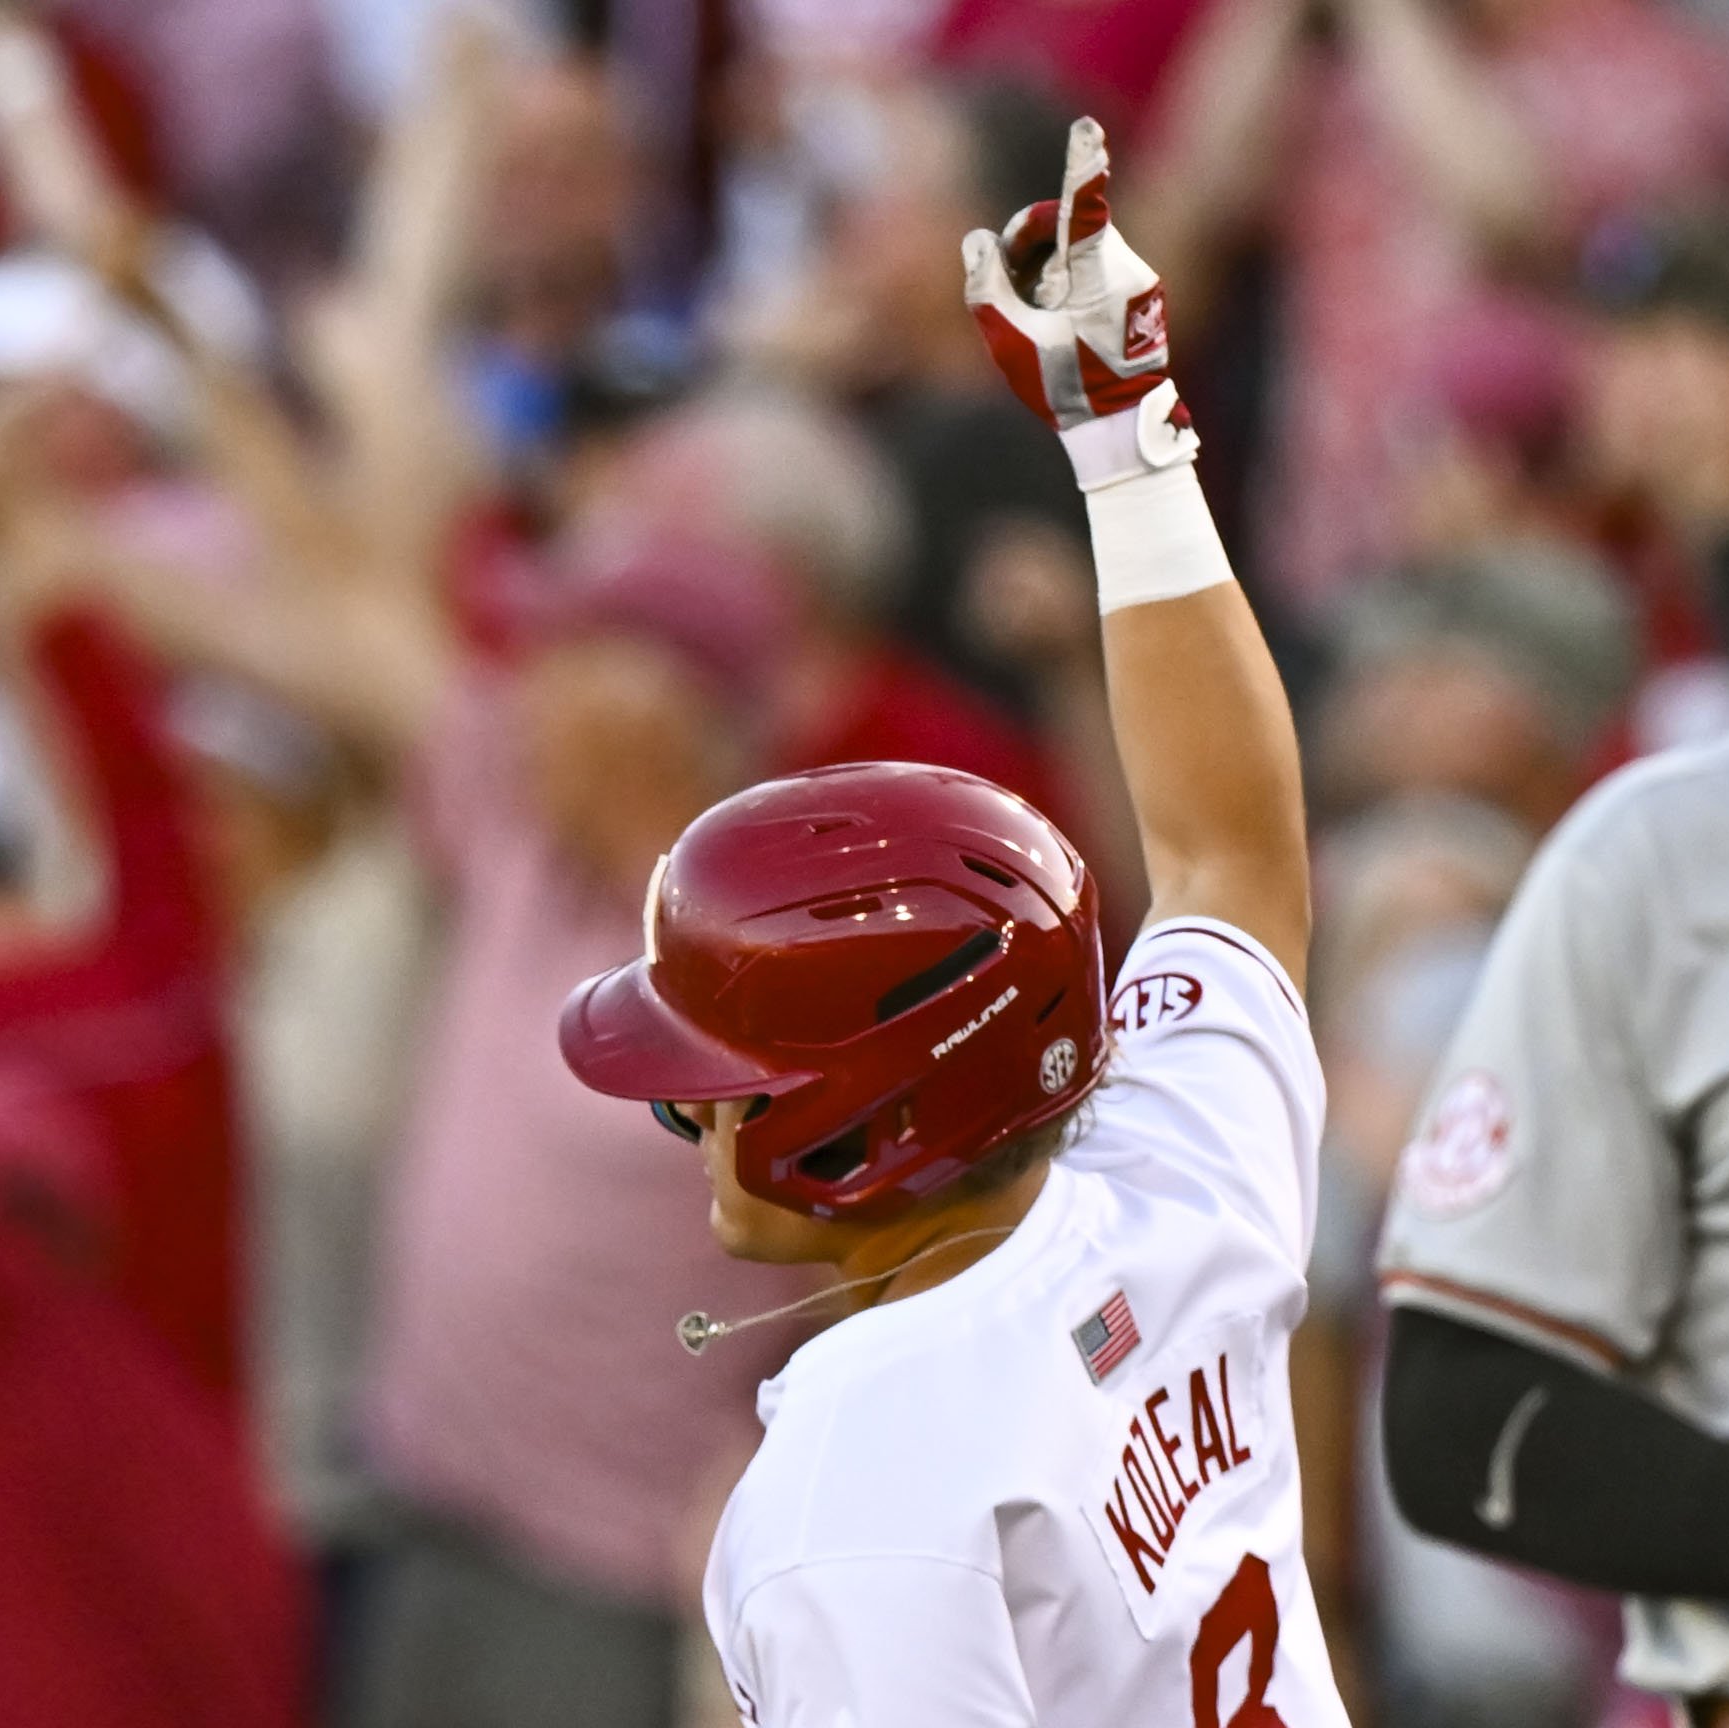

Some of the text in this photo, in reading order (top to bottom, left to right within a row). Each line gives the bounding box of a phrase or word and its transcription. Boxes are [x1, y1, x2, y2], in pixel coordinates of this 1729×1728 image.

[930, 985, 1019, 1060] RAWLINGS
[1040, 1040, 1077, 1092] SEC
[1105, 1352, 1254, 1596] KOZEAL
